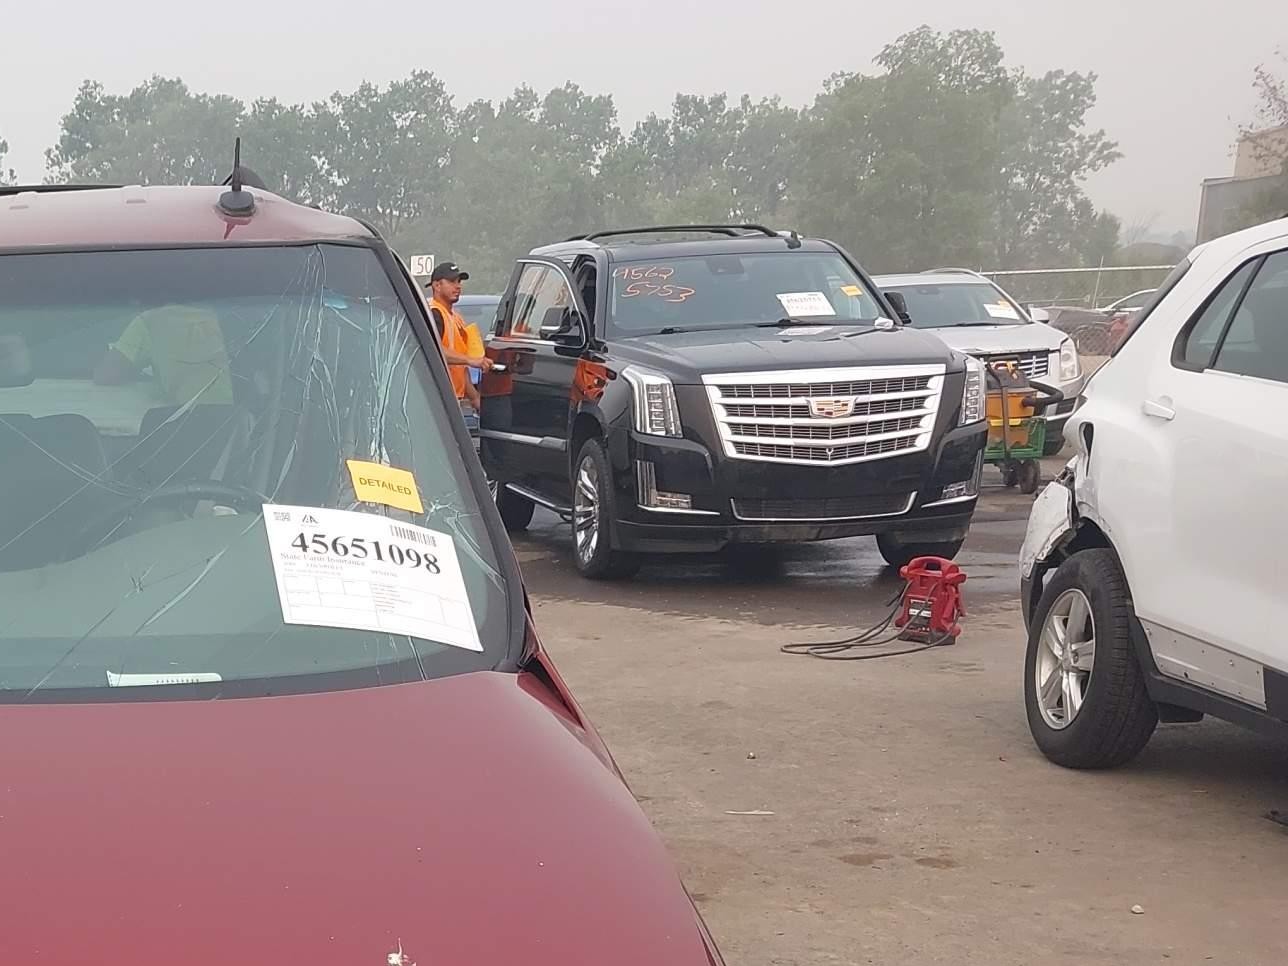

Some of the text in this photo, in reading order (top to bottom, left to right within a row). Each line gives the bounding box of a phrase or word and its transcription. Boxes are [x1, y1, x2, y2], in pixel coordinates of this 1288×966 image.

[416, 256, 433, 274] 50
[358, 476, 412, 496] DETAILED
[291, 531, 441, 575] 45651098
